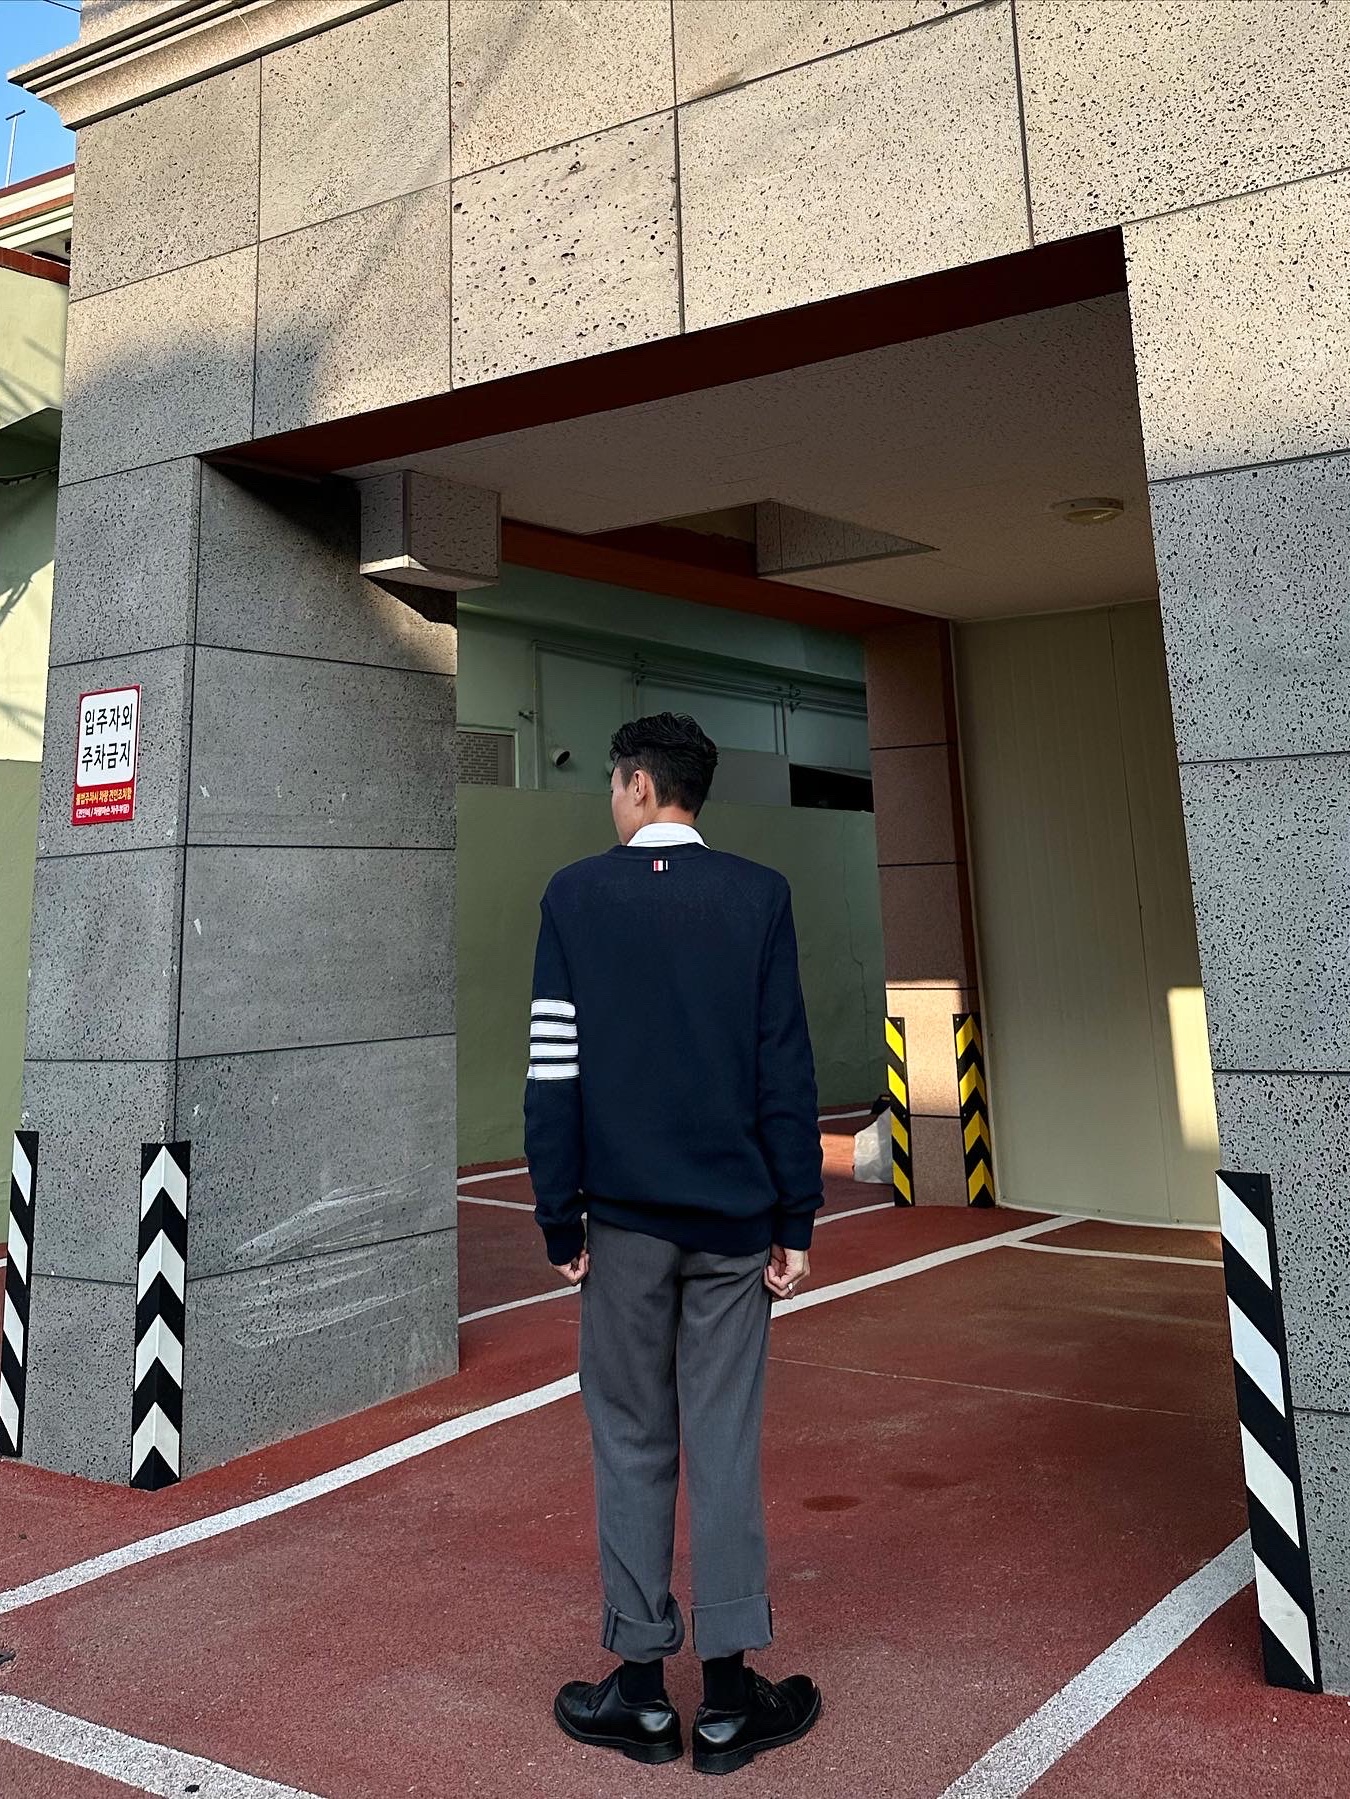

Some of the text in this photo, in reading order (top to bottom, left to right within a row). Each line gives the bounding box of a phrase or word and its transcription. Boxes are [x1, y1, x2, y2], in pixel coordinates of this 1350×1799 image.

[84, 703, 133, 736] 입주자외
[81, 739, 131, 772] 주차금지
[99, 790, 109, 803] 차량
